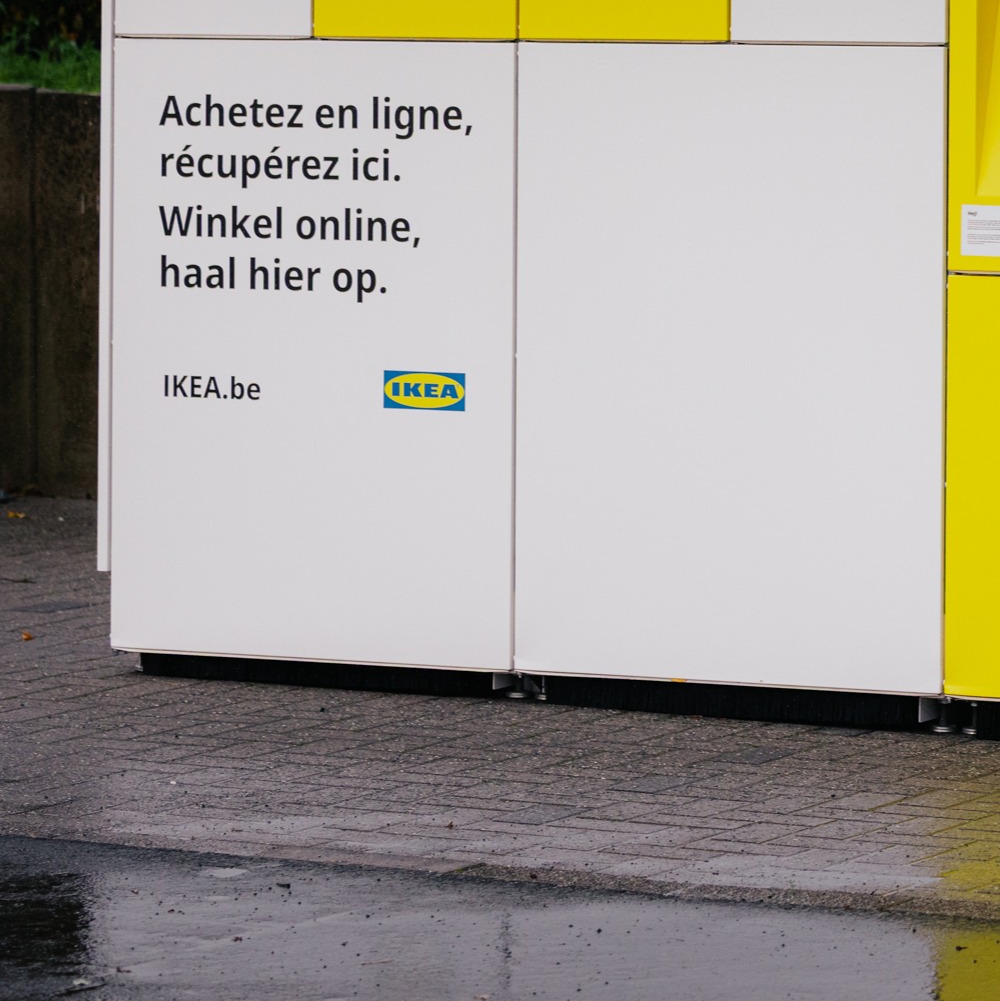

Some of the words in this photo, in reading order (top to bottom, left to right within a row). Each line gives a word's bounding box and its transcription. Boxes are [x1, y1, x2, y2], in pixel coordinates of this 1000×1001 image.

[160, 95, 303, 128] Achetez
[316, 104, 357, 129] en
[373, 96, 473, 140] ligne,
[161, 144, 339, 188] récupérez
[353, 148, 401, 181] ici.
[159, 205, 282, 239] Winkel
[297, 207, 420, 248] online,
[161, 255, 234, 289] haal
[250, 258, 320, 291] hier
[333, 269, 387, 301] op.
[164, 374, 260, 401] IKEA.be
[392, 381, 459, 399] IKEA
